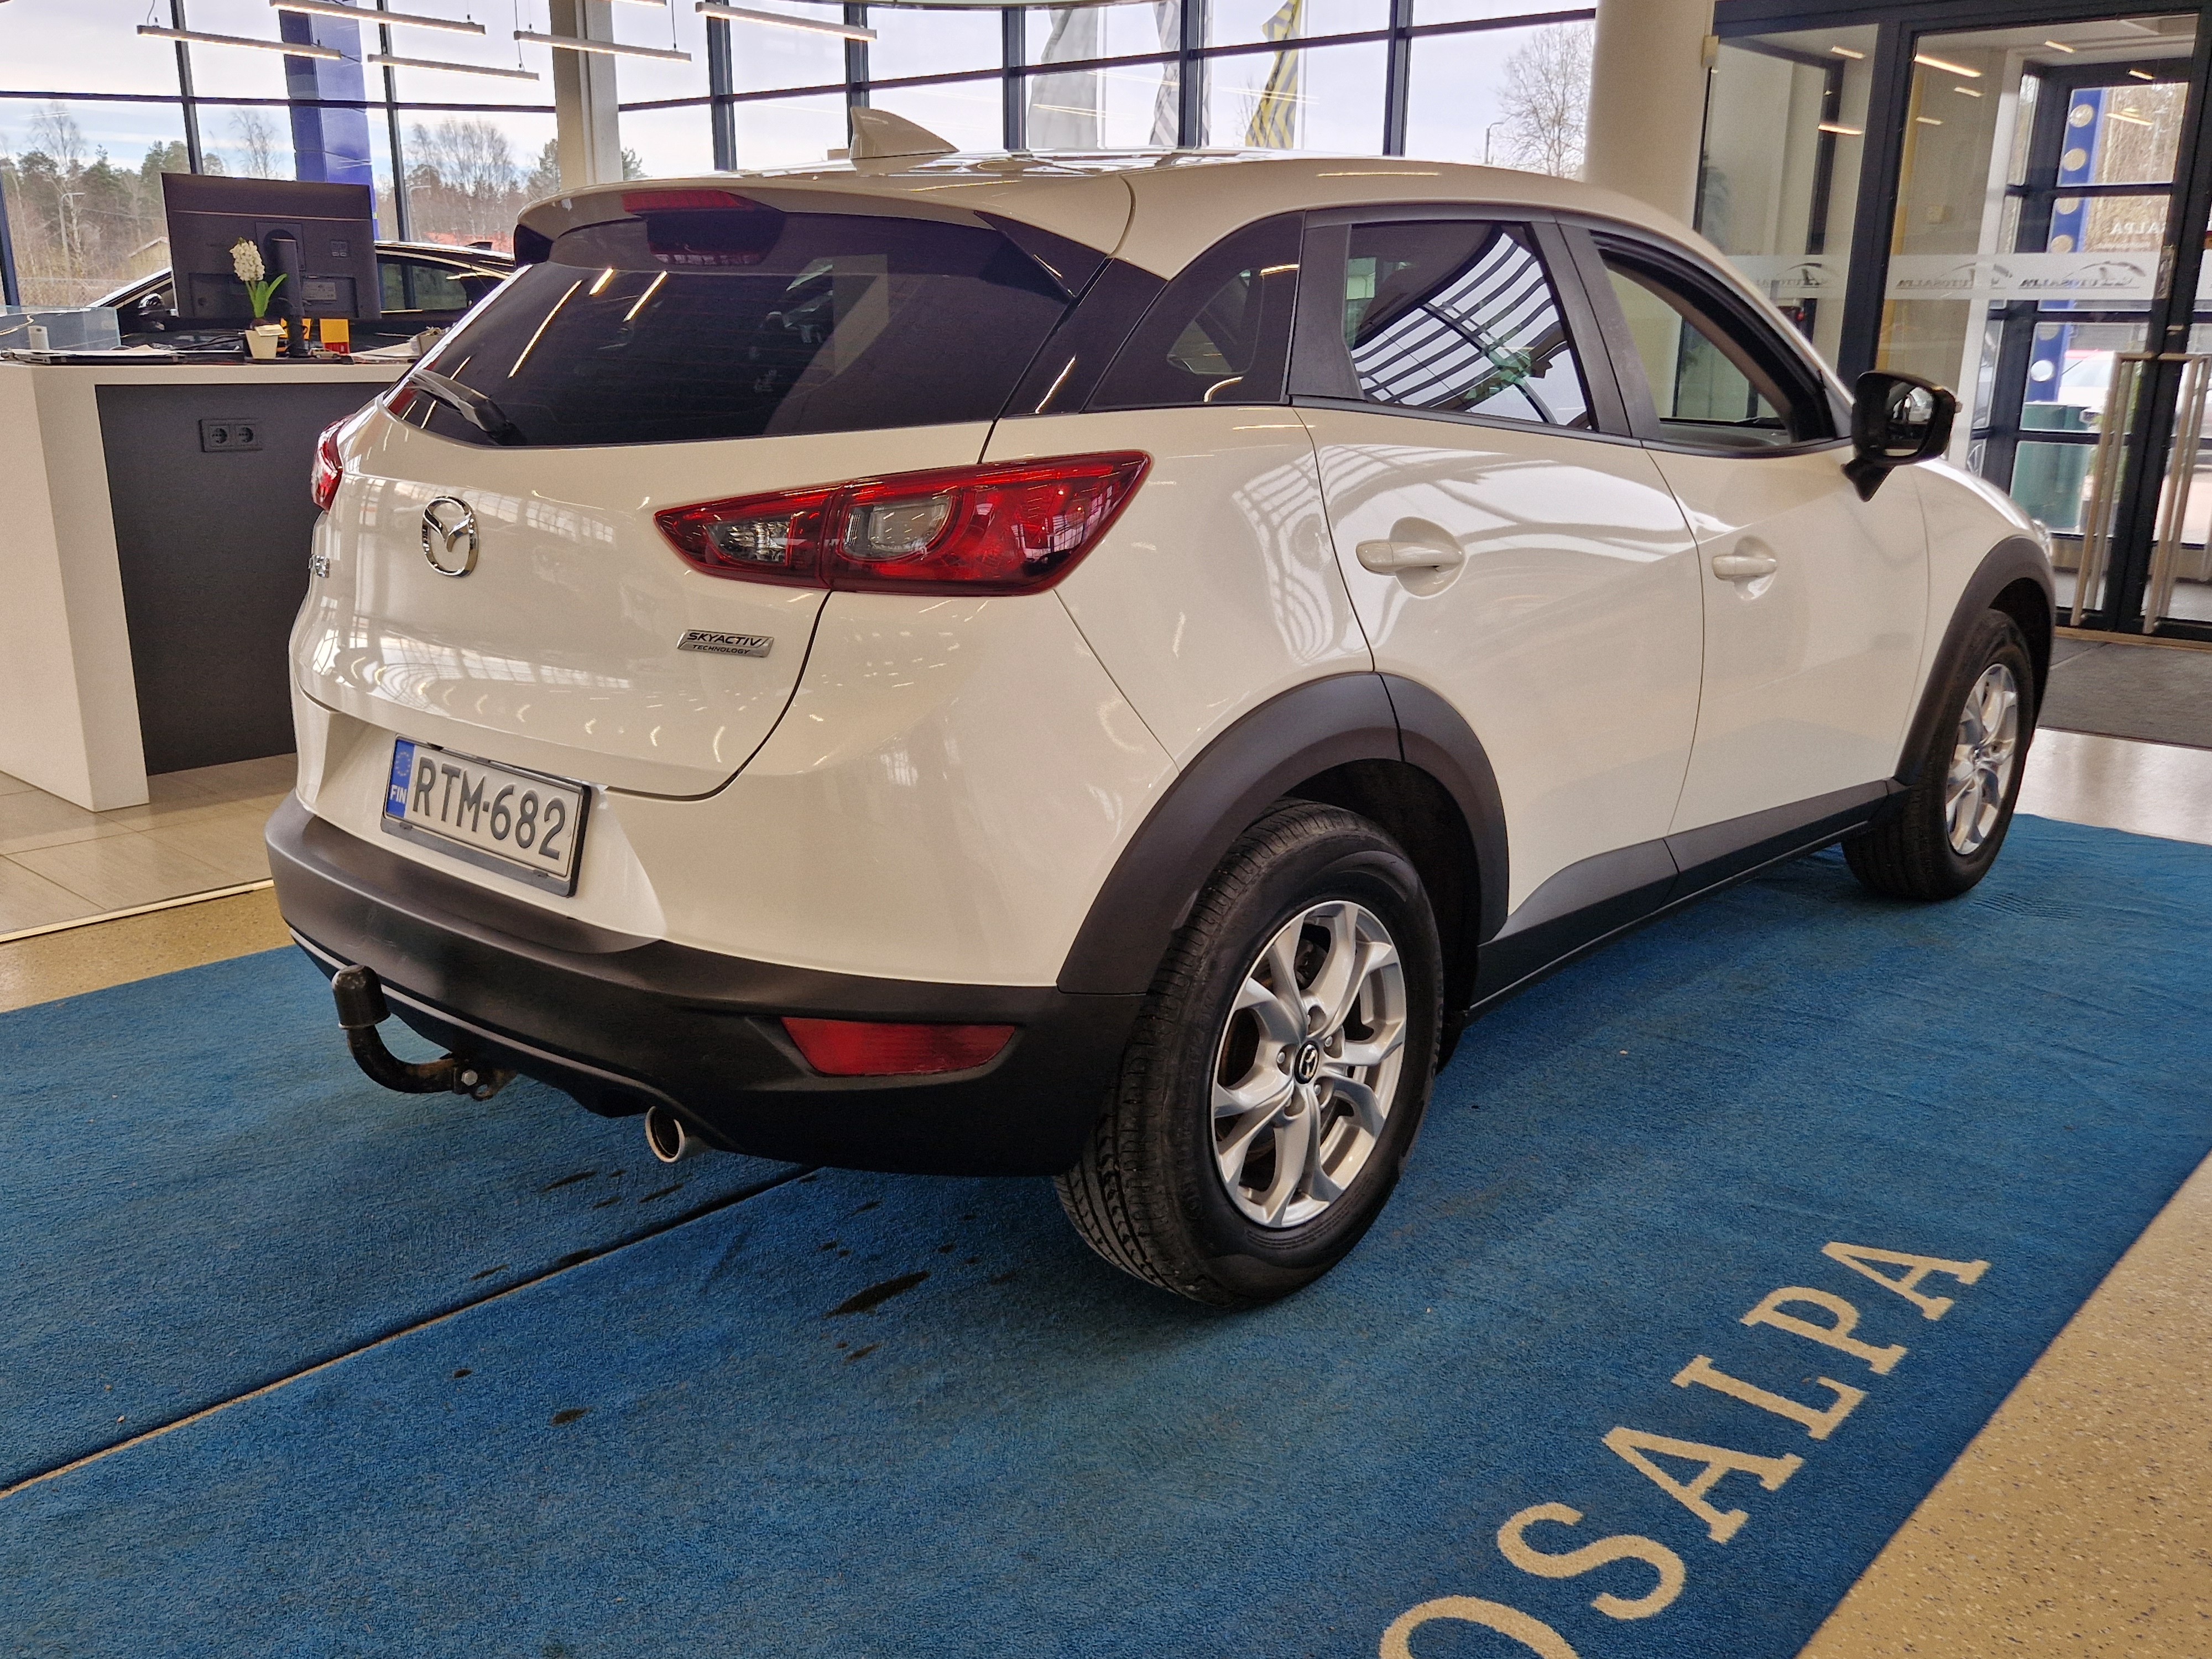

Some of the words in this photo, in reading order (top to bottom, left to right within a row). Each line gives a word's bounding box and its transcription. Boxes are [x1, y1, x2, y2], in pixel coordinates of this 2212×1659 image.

[687, 632, 763, 646] SKYACTIV
[692, 644, 751, 654] TECHNOLOGY
[390, 784, 407, 805] FIN
[412, 756, 566, 860] RTM-682
